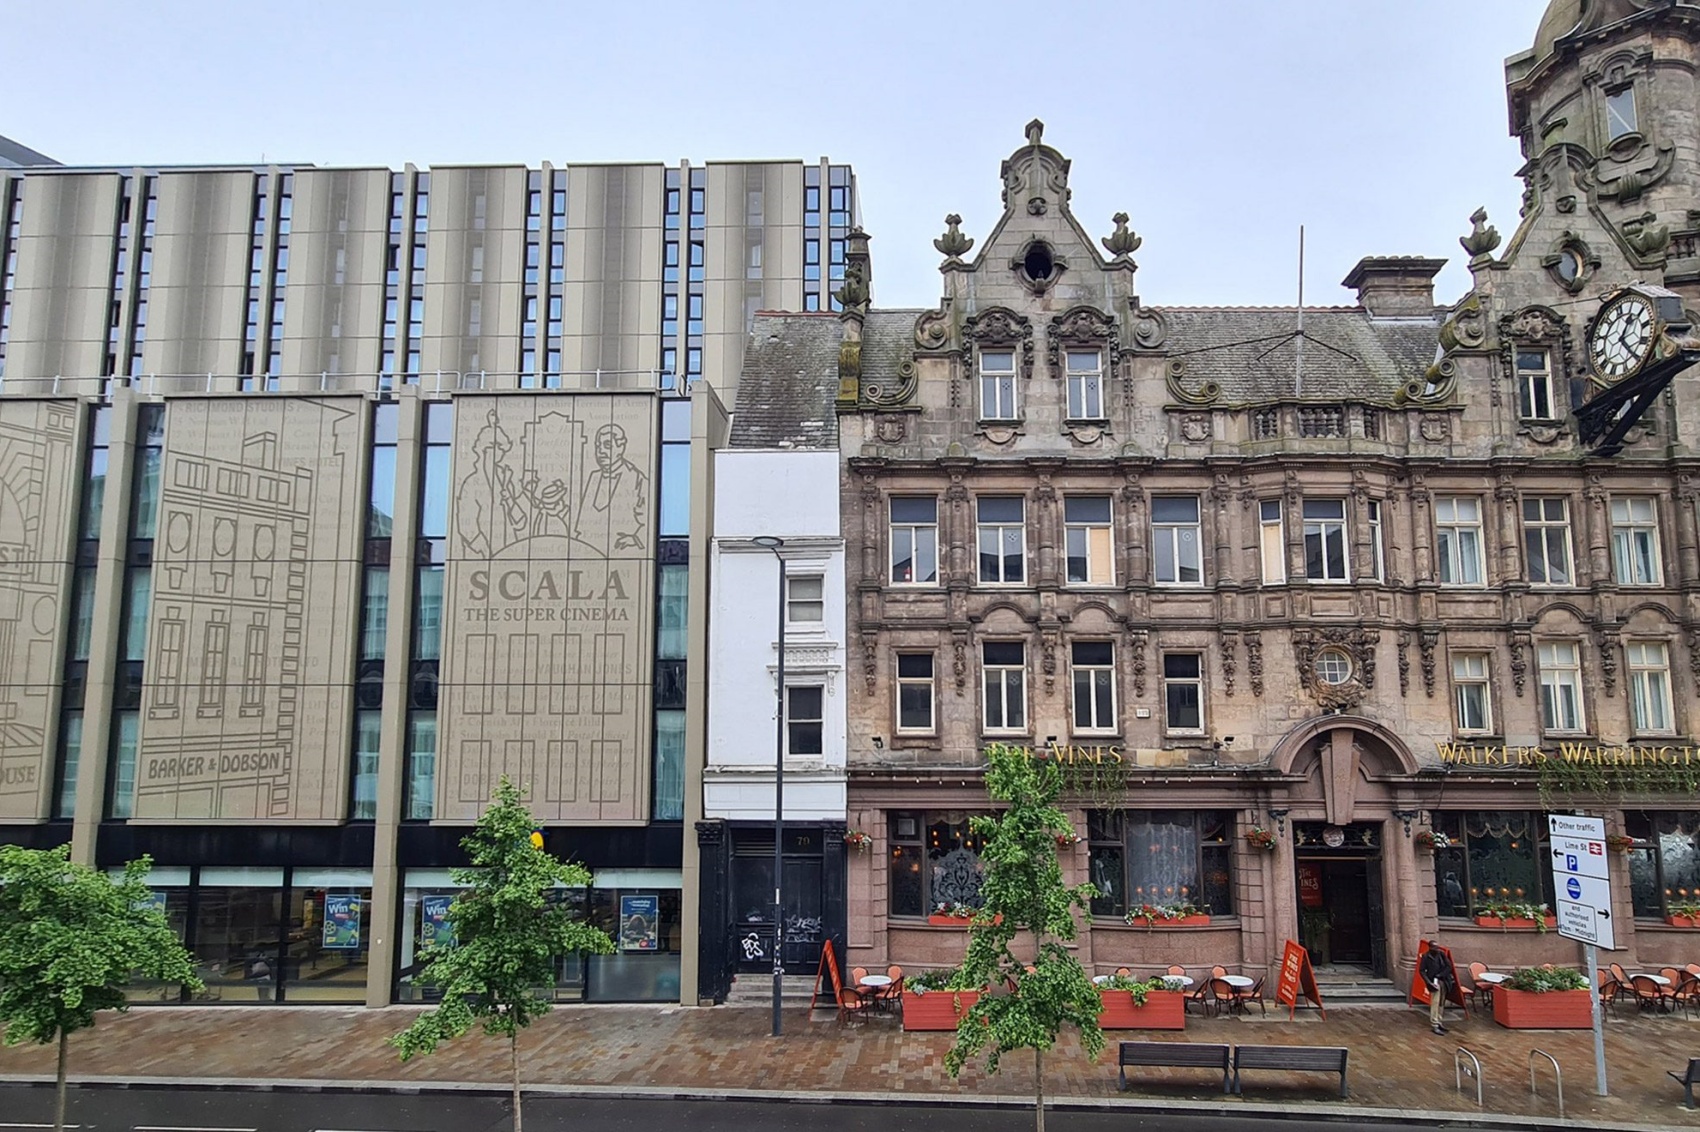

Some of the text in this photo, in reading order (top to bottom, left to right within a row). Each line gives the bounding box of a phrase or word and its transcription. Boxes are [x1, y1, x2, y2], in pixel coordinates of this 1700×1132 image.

[469, 569, 630, 601] SCALA
[463, 607, 629, 622] THE SUPER CINEMA
[595, 663, 632, 675] JONES
[1050, 741, 1122, 765] VINES
[1434, 741, 1700, 766] WALKERS WARRINGT
[148, 756, 205, 780] BARKER
[208, 758, 217, 770] &
[221, 752, 280, 774] DOBSON
[1558, 821, 1596, 832] Other traffic
[1565, 841, 1588, 851] Lime St
[328, 903, 349, 914] Win
[426, 904, 447, 915] Win
